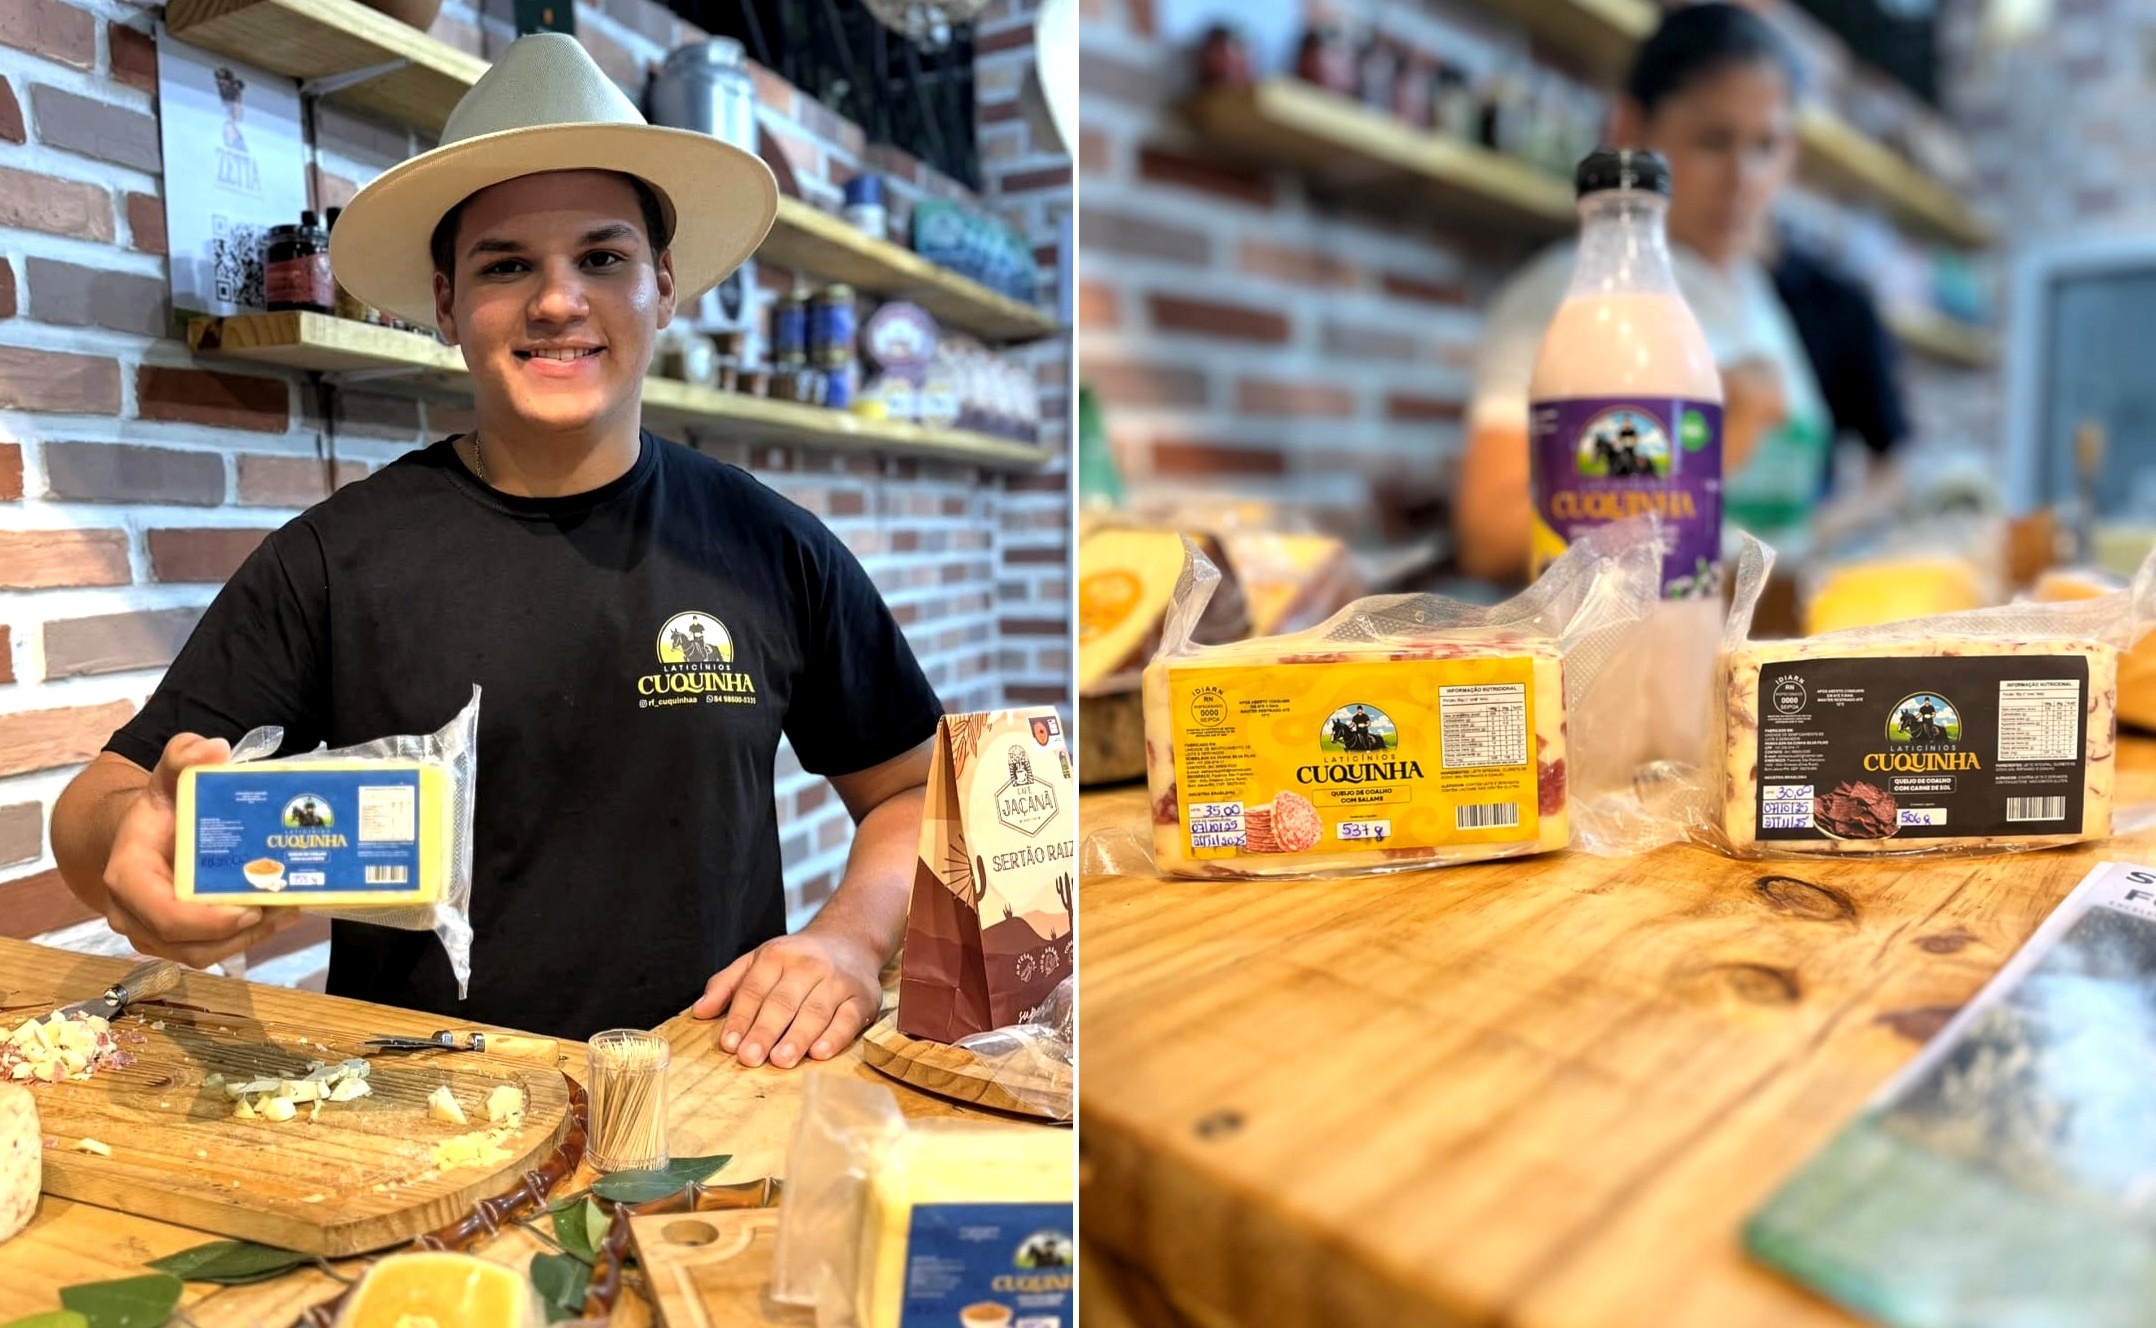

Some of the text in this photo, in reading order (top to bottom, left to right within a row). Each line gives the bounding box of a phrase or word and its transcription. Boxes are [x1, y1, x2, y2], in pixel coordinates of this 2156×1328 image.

[663, 662, 731, 672] LATICÍNIOS
[637, 672, 756, 695] CUQUINHA
[1775, 674, 1805, 685] IDIARN
[1192, 686, 1223, 696] IDIARN
[1200, 709, 1219, 717] 0000
[1890, 744, 1957, 752] LATICÍNIOS
[1324, 754, 1396, 763] LATICÍNIOS
[1863, 752, 1982, 772] CUQUINHA
[1296, 761, 1424, 784] CUQUINHA
[1331, 789, 1354, 797] QUEIJO
[1002, 790, 1054, 817] JAÇANÃ
[1204, 804, 1241, 818] 35,00
[1342, 823, 1369, 837] 537
[266, 834, 348, 848] CUQUINHA
[992, 845, 1045, 872] SERTÃO
